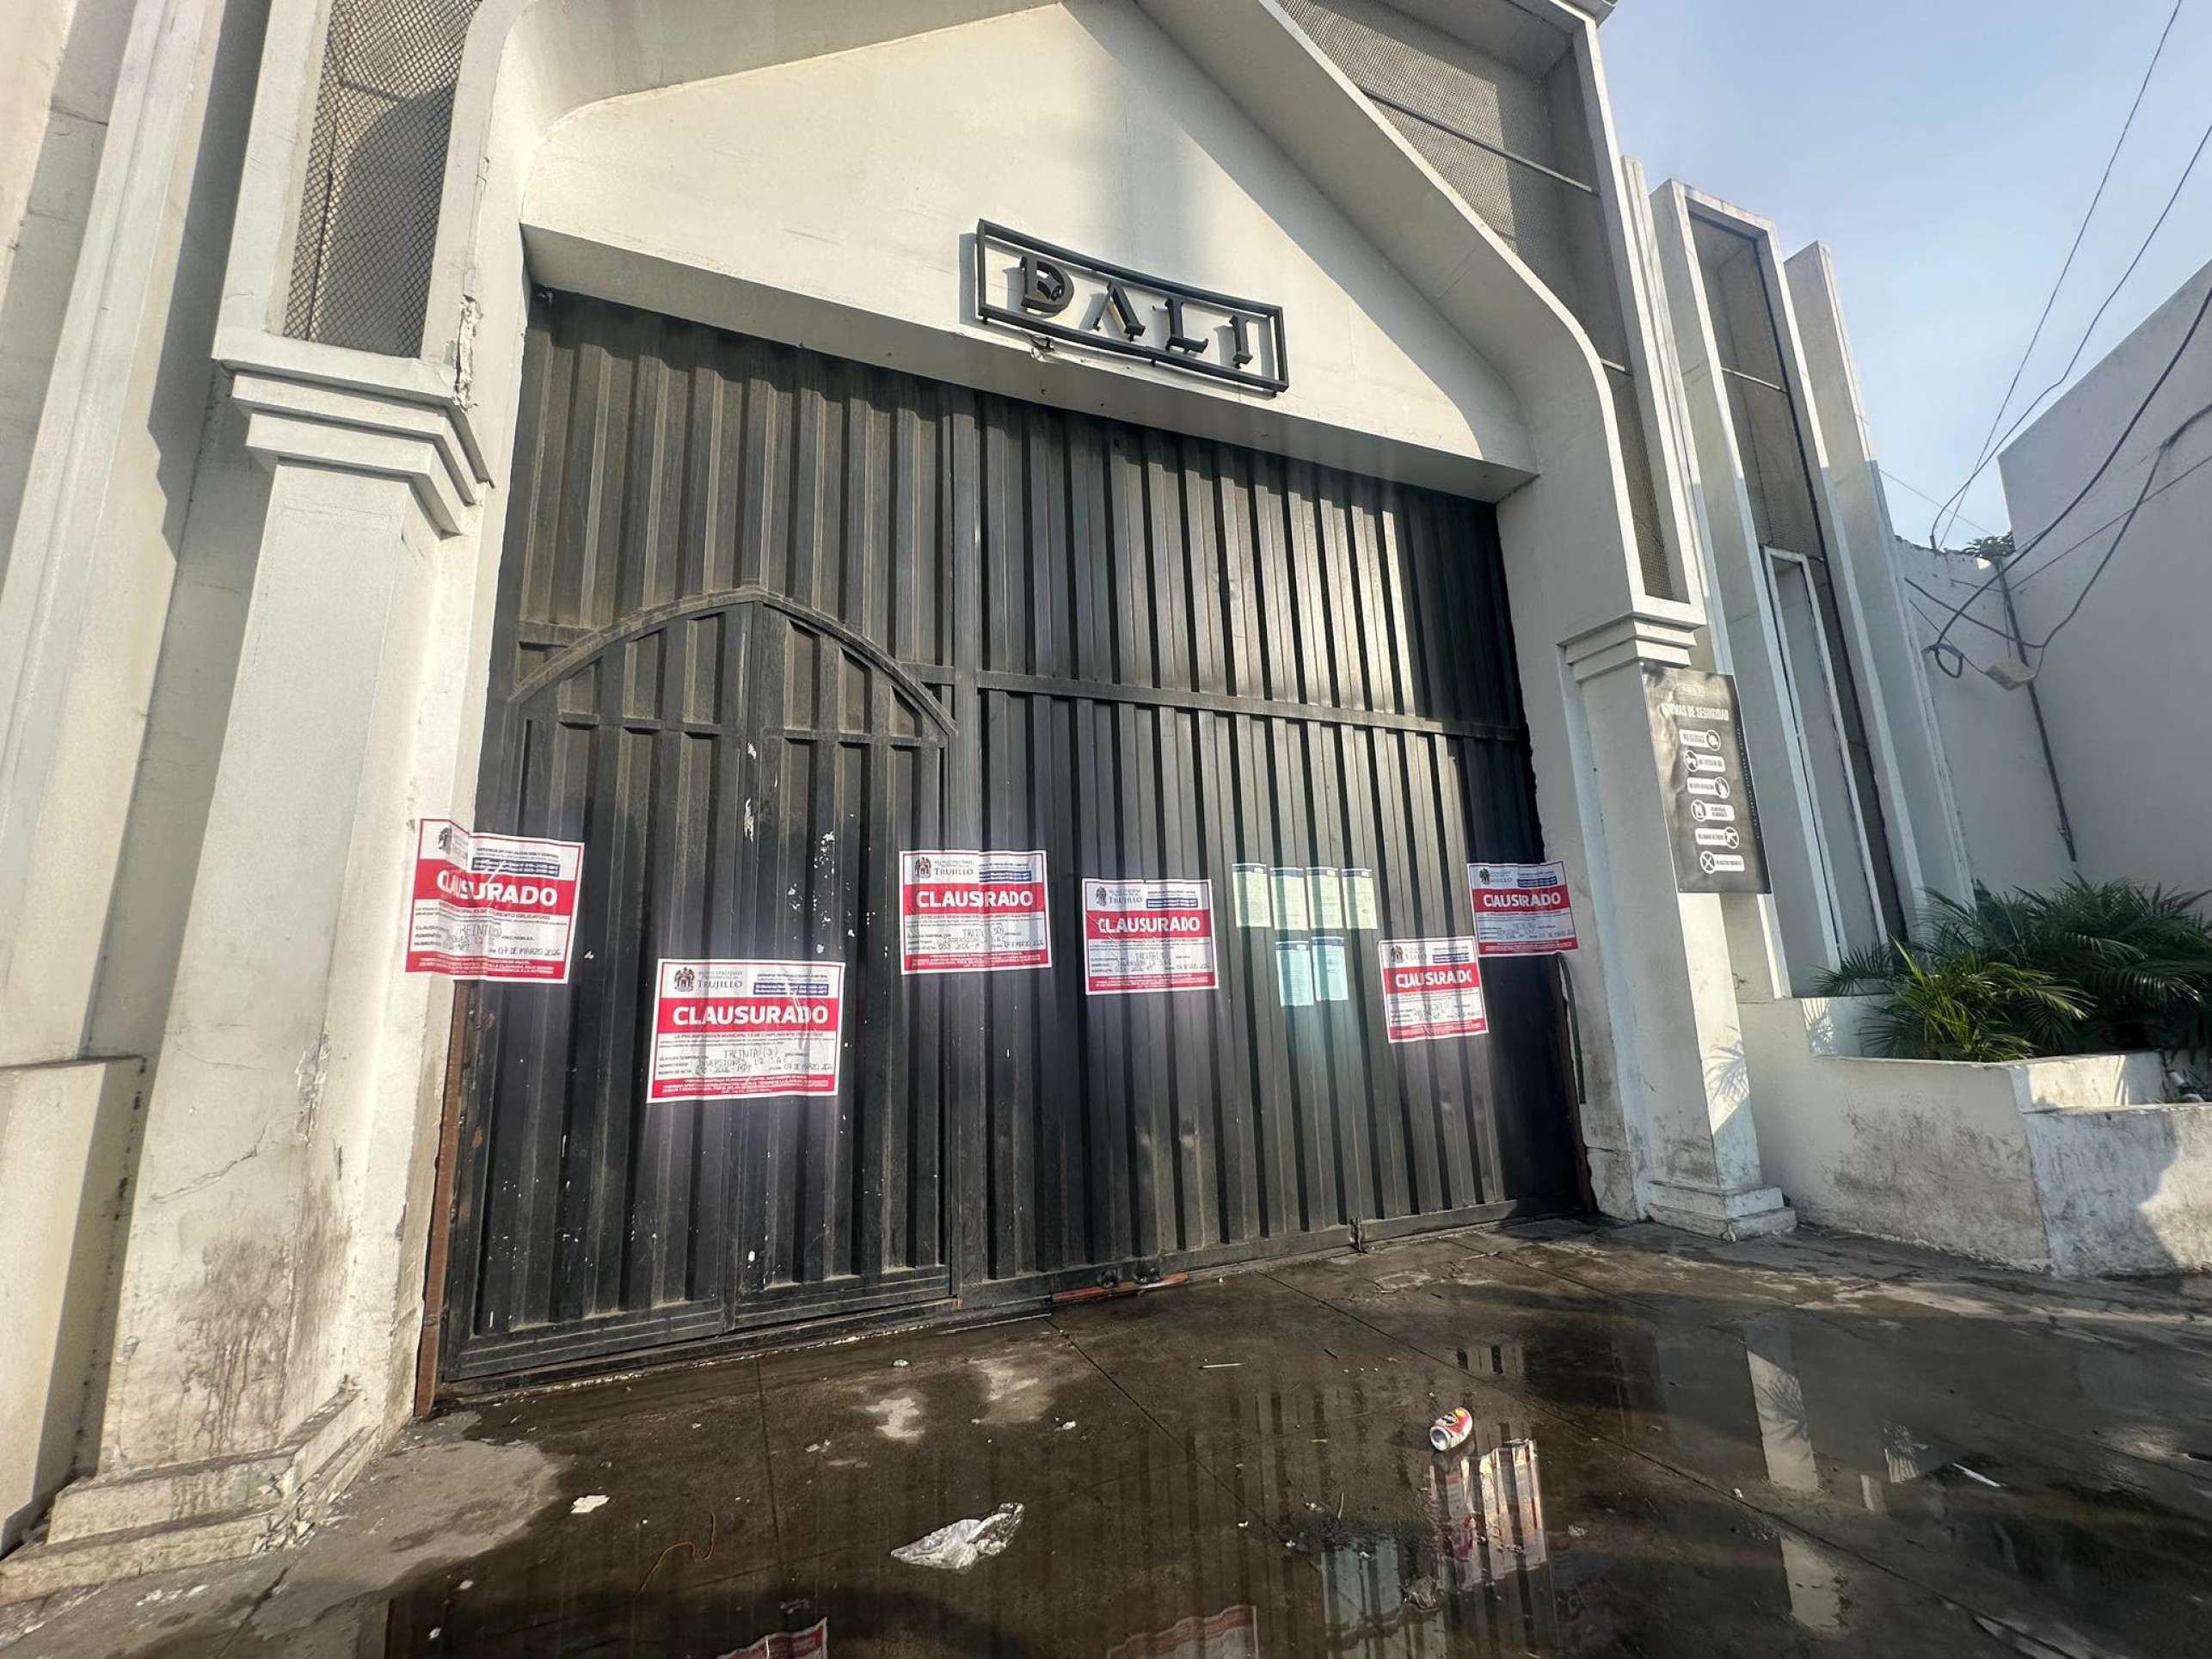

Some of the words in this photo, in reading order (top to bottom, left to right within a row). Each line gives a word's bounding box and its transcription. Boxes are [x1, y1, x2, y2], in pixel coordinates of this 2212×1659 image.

[1019, 255, 1253, 366] DALI
[697, 979, 743, 988] TRUJILLO
[673, 1005, 829, 1025] CLAUSURADO
